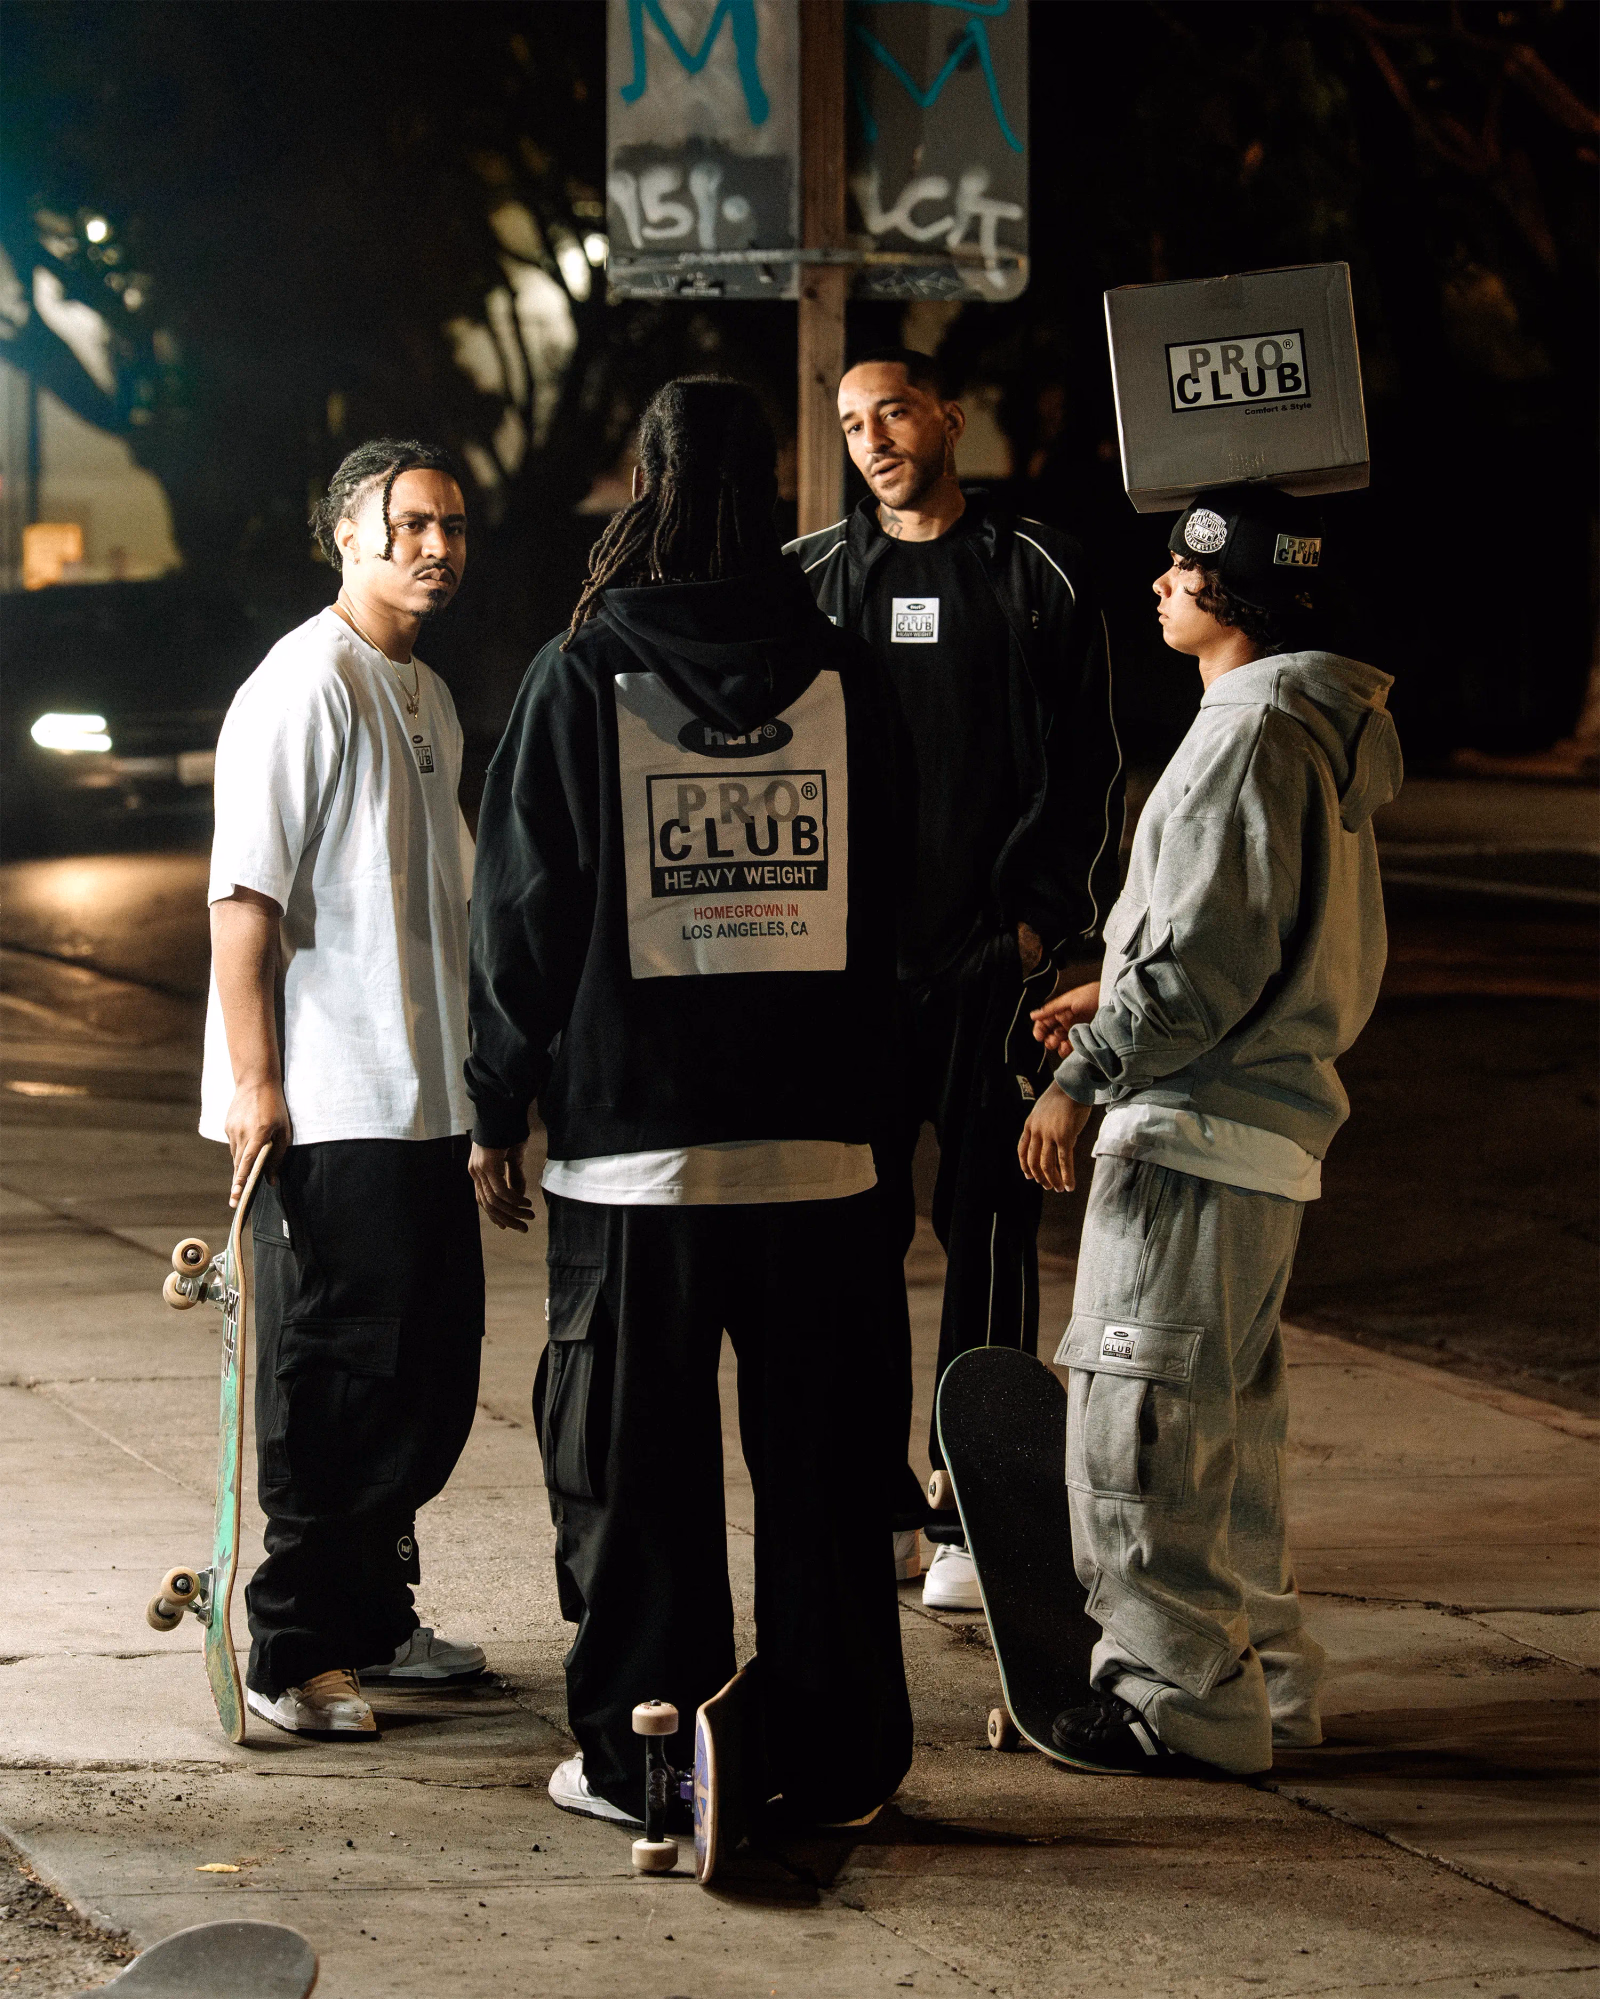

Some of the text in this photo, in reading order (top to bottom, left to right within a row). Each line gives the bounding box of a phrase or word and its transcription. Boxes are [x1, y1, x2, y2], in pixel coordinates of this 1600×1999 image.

[1176, 362, 1302, 405] CLUB
[1244, 405, 1279, 415] Comfort
[1290, 401, 1312, 411] Style
[1279, 548, 1319, 565] CLUB
[898, 621, 932, 631] CLUB
[659, 815, 820, 862] CLUB
[664, 866, 817, 890] HEAVY WEIGHT
[694, 904, 799, 920] HOMEGROWN IN
[682, 921, 809, 940] LOS ANGELES, CA
[1105, 1344, 1131, 1353] CLUB
